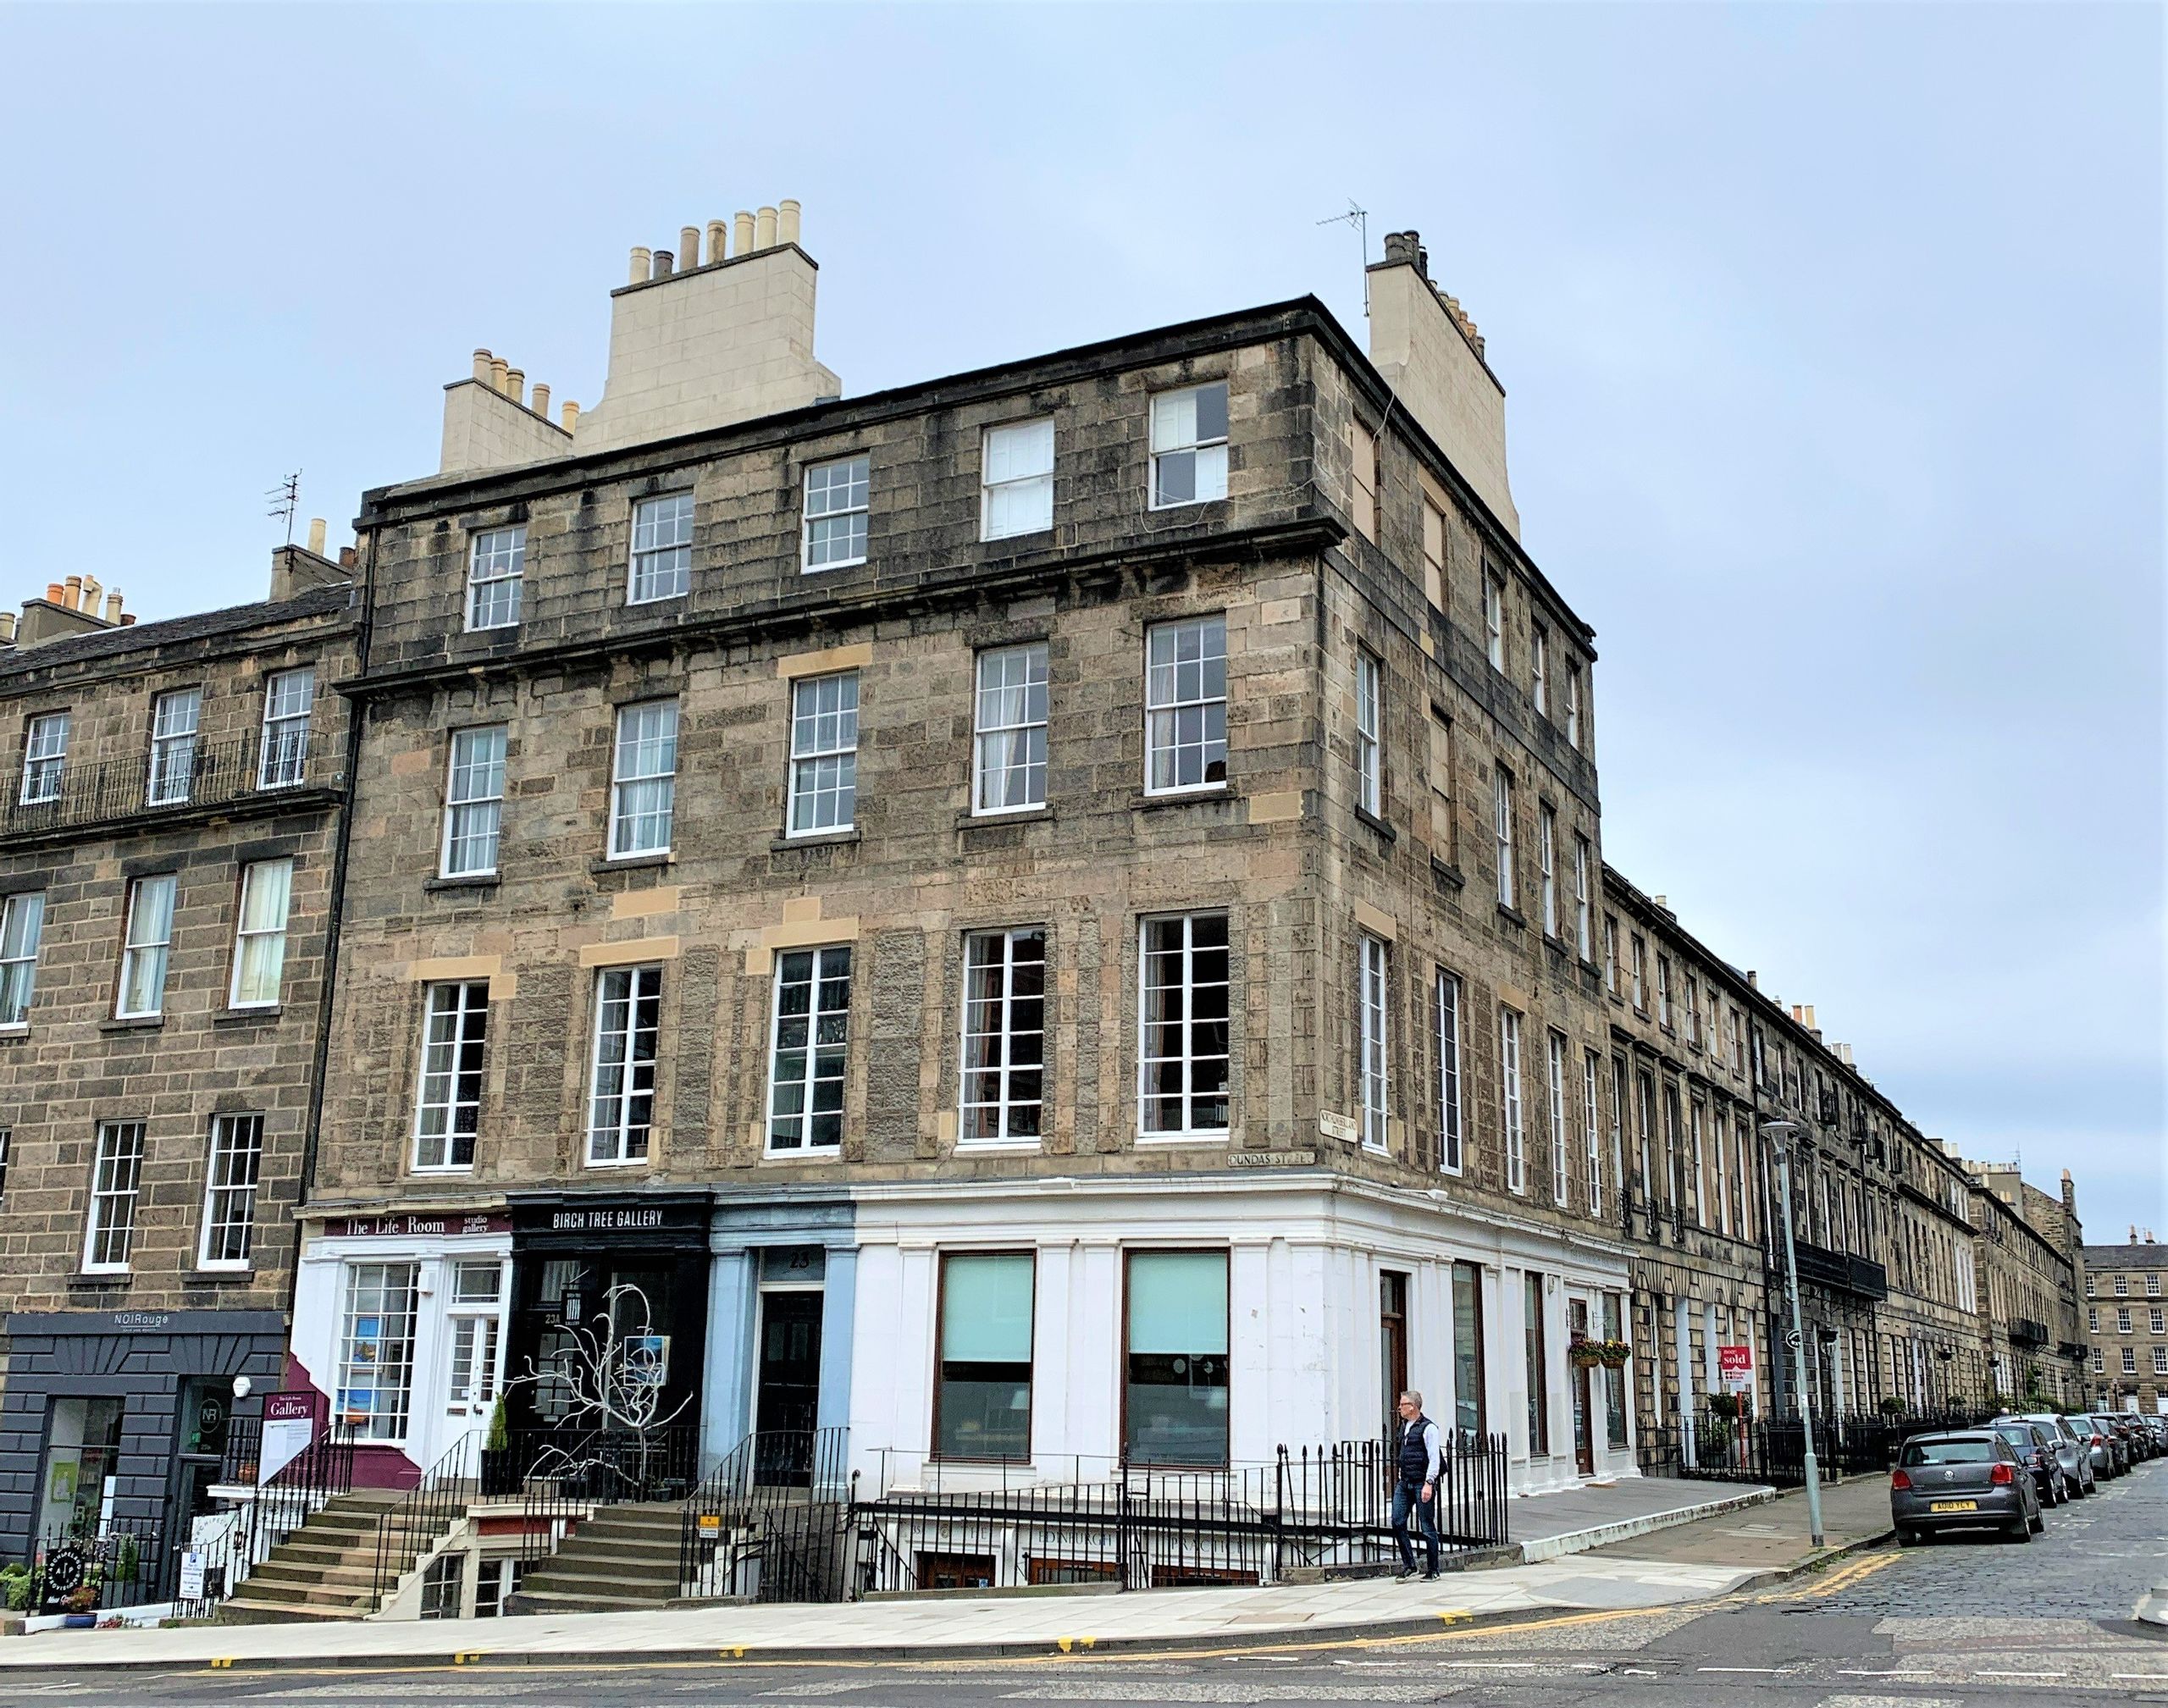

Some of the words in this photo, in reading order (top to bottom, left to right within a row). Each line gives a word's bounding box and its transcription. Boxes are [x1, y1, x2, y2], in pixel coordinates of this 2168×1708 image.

[1230, 1154, 1270, 1165] DUNDAS
[464, 1216, 487, 1224] studio
[553, 1213, 584, 1228] BIRCH
[589, 1211, 613, 1227] TREE
[617, 1210, 662, 1226] GALLERY
[345, 1219, 368, 1235] The
[375, 1217, 400, 1235] Life
[406, 1216, 445, 1233] Room
[462, 1224, 488, 1234] gallery
[790, 1252, 810, 1269] 23
[545, 1313, 561, 1324] 23A
[1723, 1354, 1746, 1364] sold
[270, 1402, 308, 1418] Gallery
